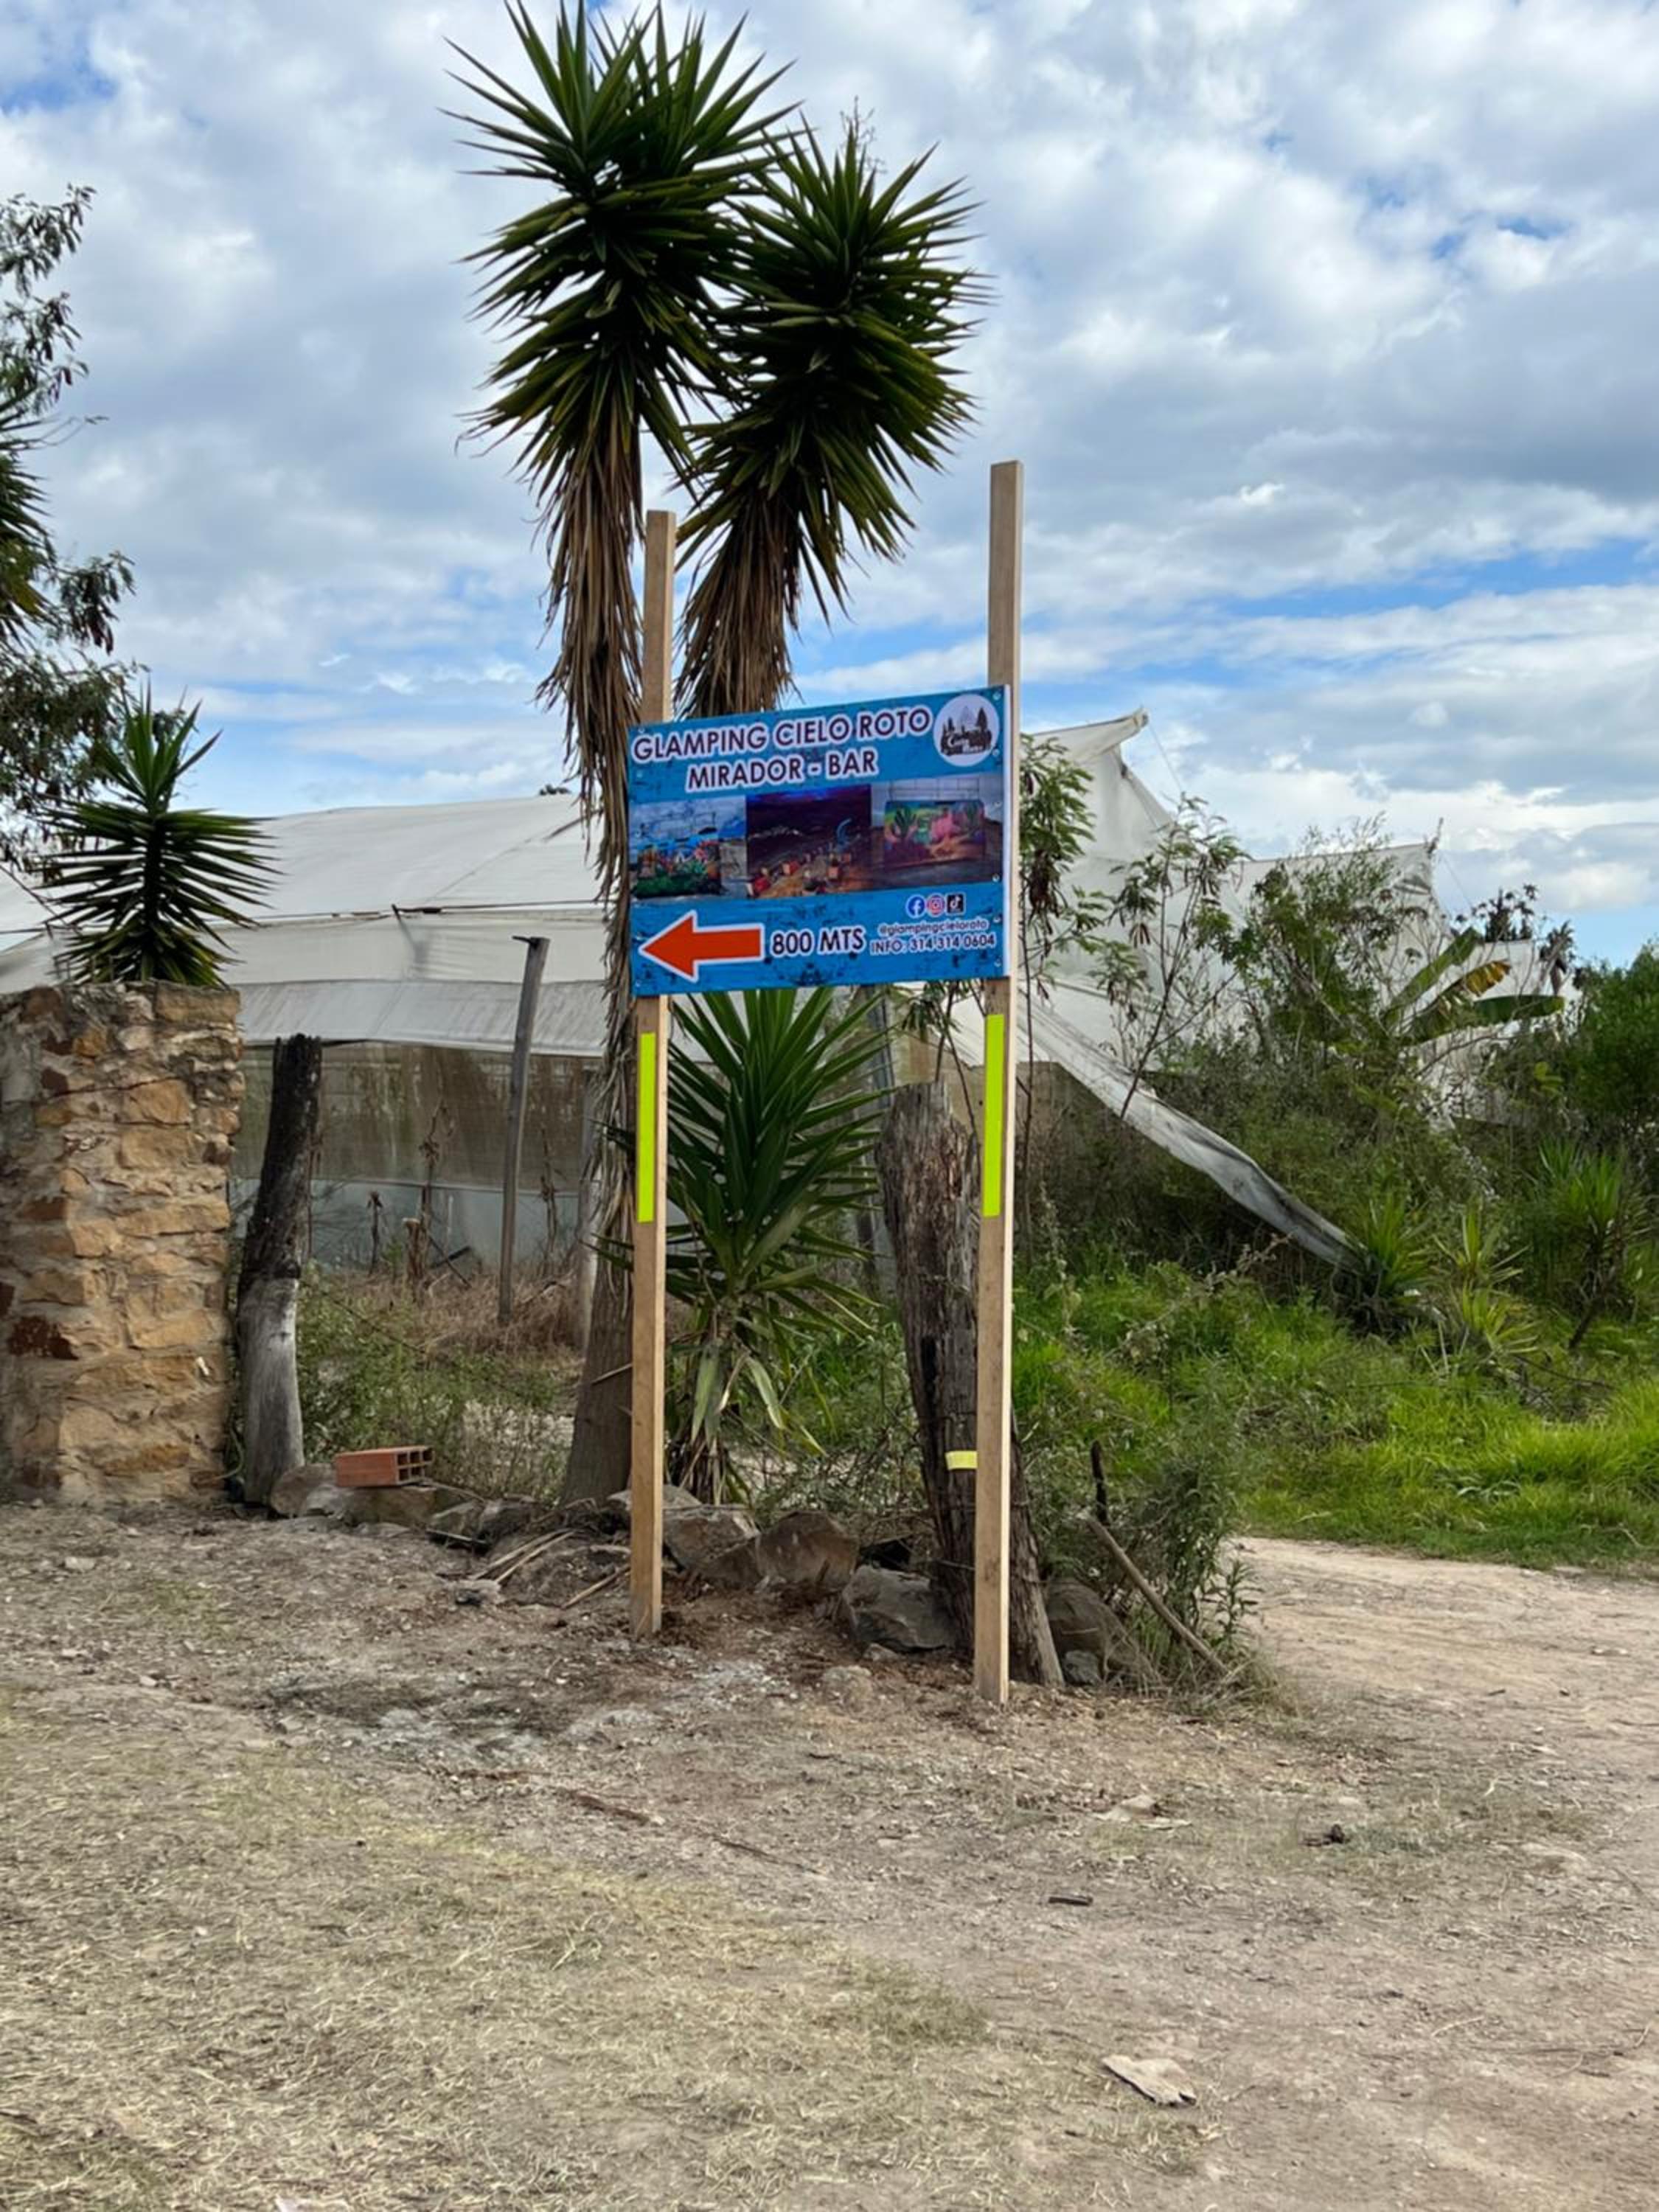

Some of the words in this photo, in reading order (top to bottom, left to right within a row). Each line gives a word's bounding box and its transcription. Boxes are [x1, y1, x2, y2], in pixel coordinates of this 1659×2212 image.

[633, 726, 767, 762] GLAMPING
[775, 717, 850, 746] CIELO
[861, 709, 931, 737] ROTO
[686, 759, 801, 790] MIRADOR
[828, 751, 877, 775] BAR
[773, 931, 812, 955] 800
[820, 928, 864, 953] MTS
[871, 939, 905, 954] INFO:
[910, 937, 933, 952] 314
[937, 936, 960, 950] 314
[964, 933, 995, 948] 0604
